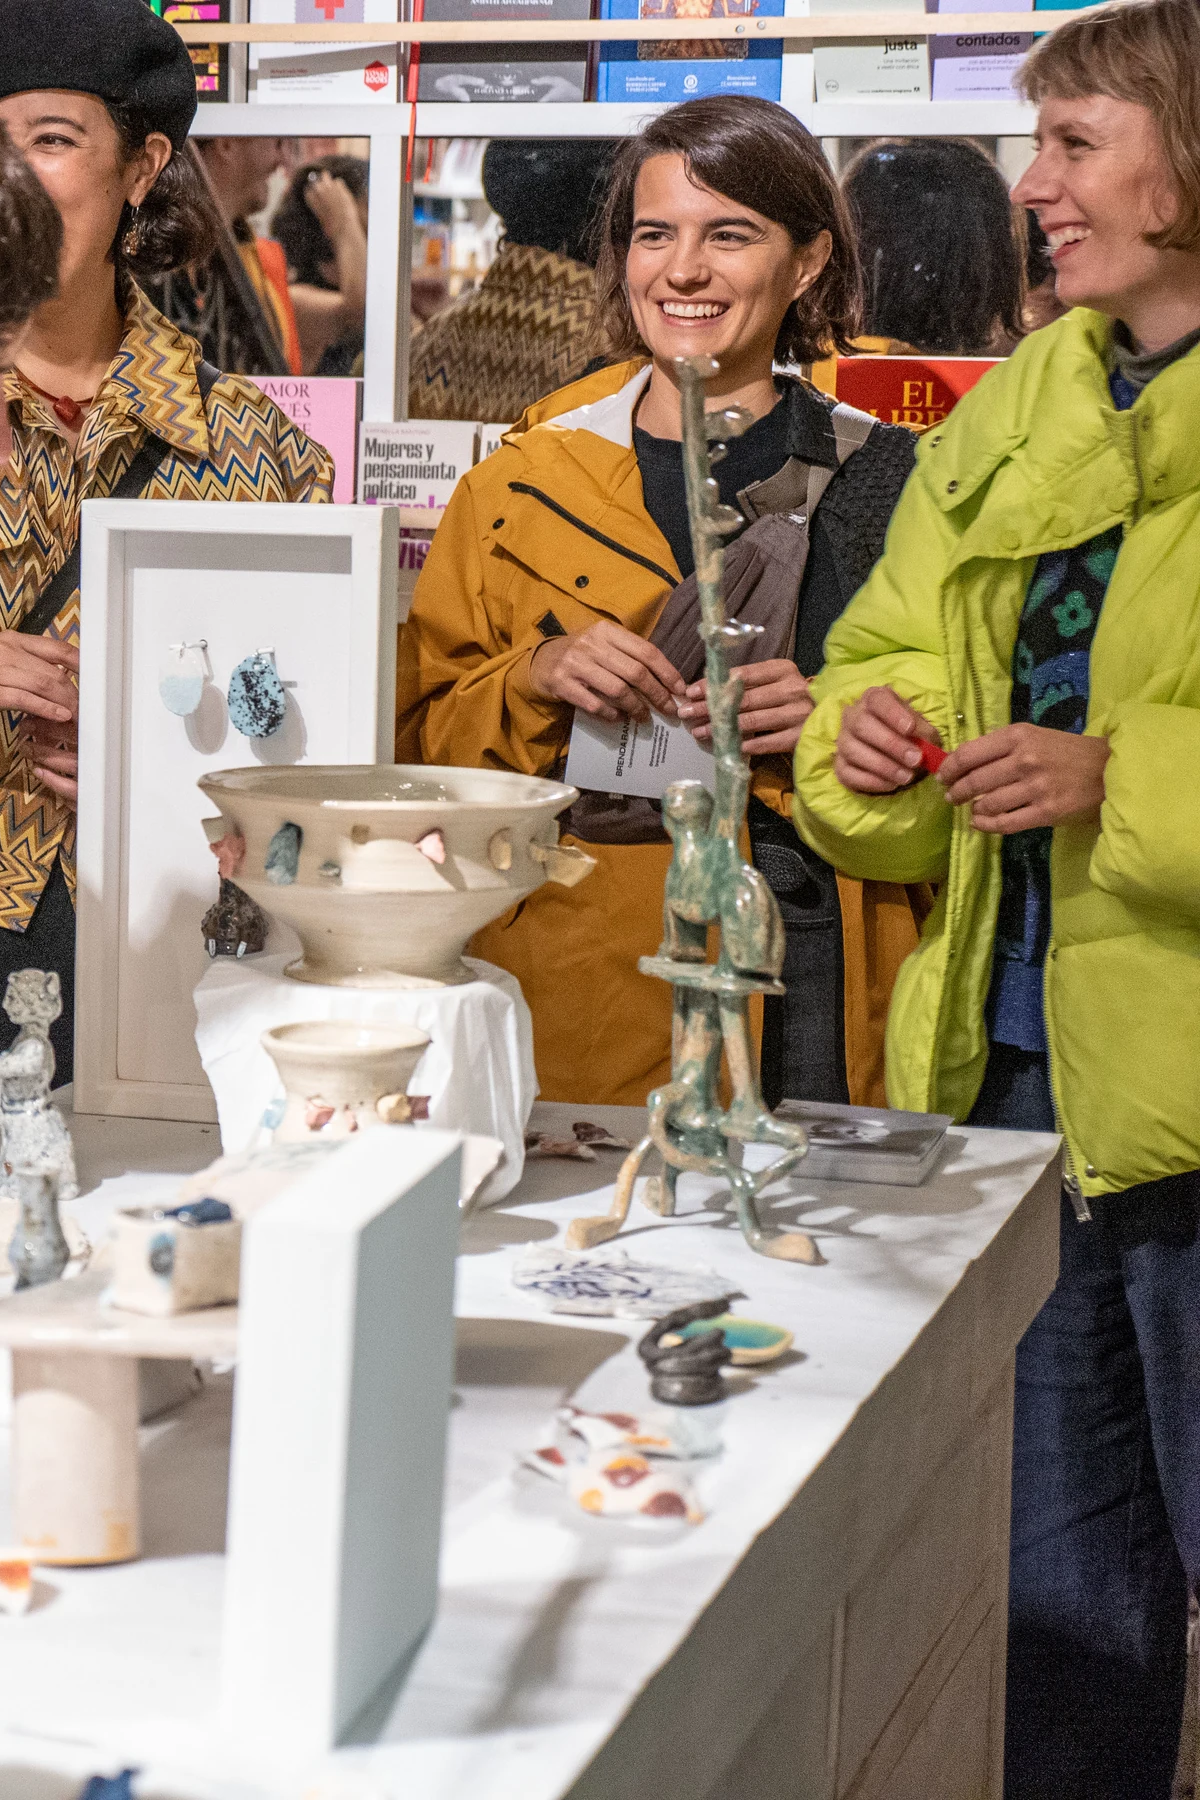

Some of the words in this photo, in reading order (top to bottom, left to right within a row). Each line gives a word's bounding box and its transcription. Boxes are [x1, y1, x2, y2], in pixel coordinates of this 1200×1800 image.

[883, 39, 918, 54] justa
[956, 33, 1020, 47] contados
[902, 381, 946, 407] EL
[364, 438, 423, 461] Mujeres
[426, 444, 434, 462] y
[363, 461, 456, 481] pensamiento
[363, 479, 417, 502] político
[615, 742, 628, 777] BRENDA
